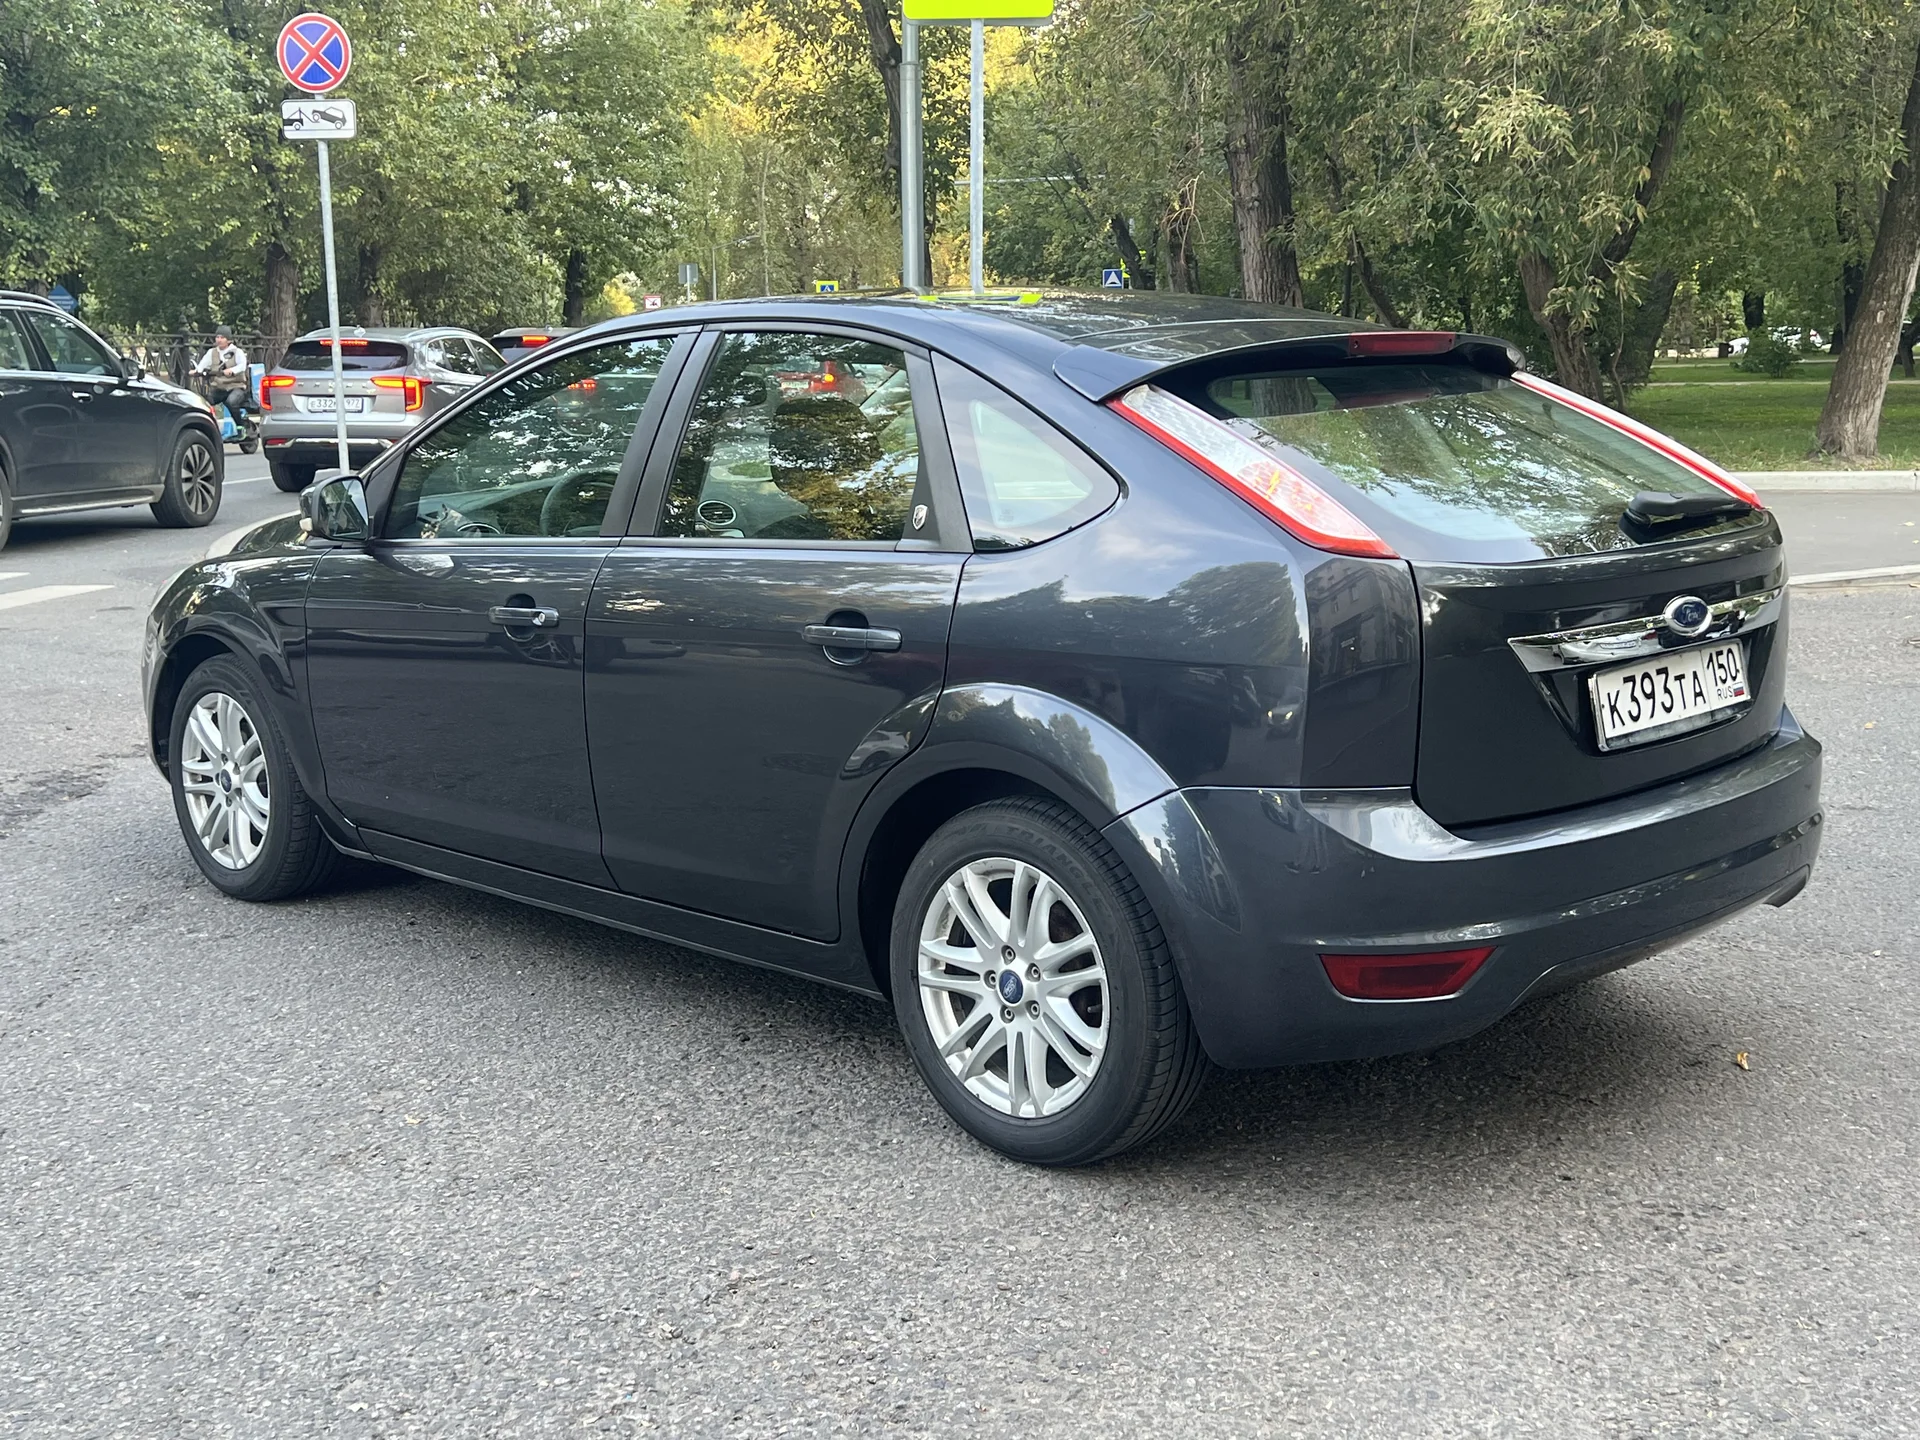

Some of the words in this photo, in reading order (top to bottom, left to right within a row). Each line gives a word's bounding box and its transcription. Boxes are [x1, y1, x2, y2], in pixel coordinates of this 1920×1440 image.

[1607, 666, 1706, 729] К393ТА
[1706, 648, 1739, 687] 150
[1717, 685, 1733, 700] RUS
[1006, 825, 1105, 910] TRIANGLE
